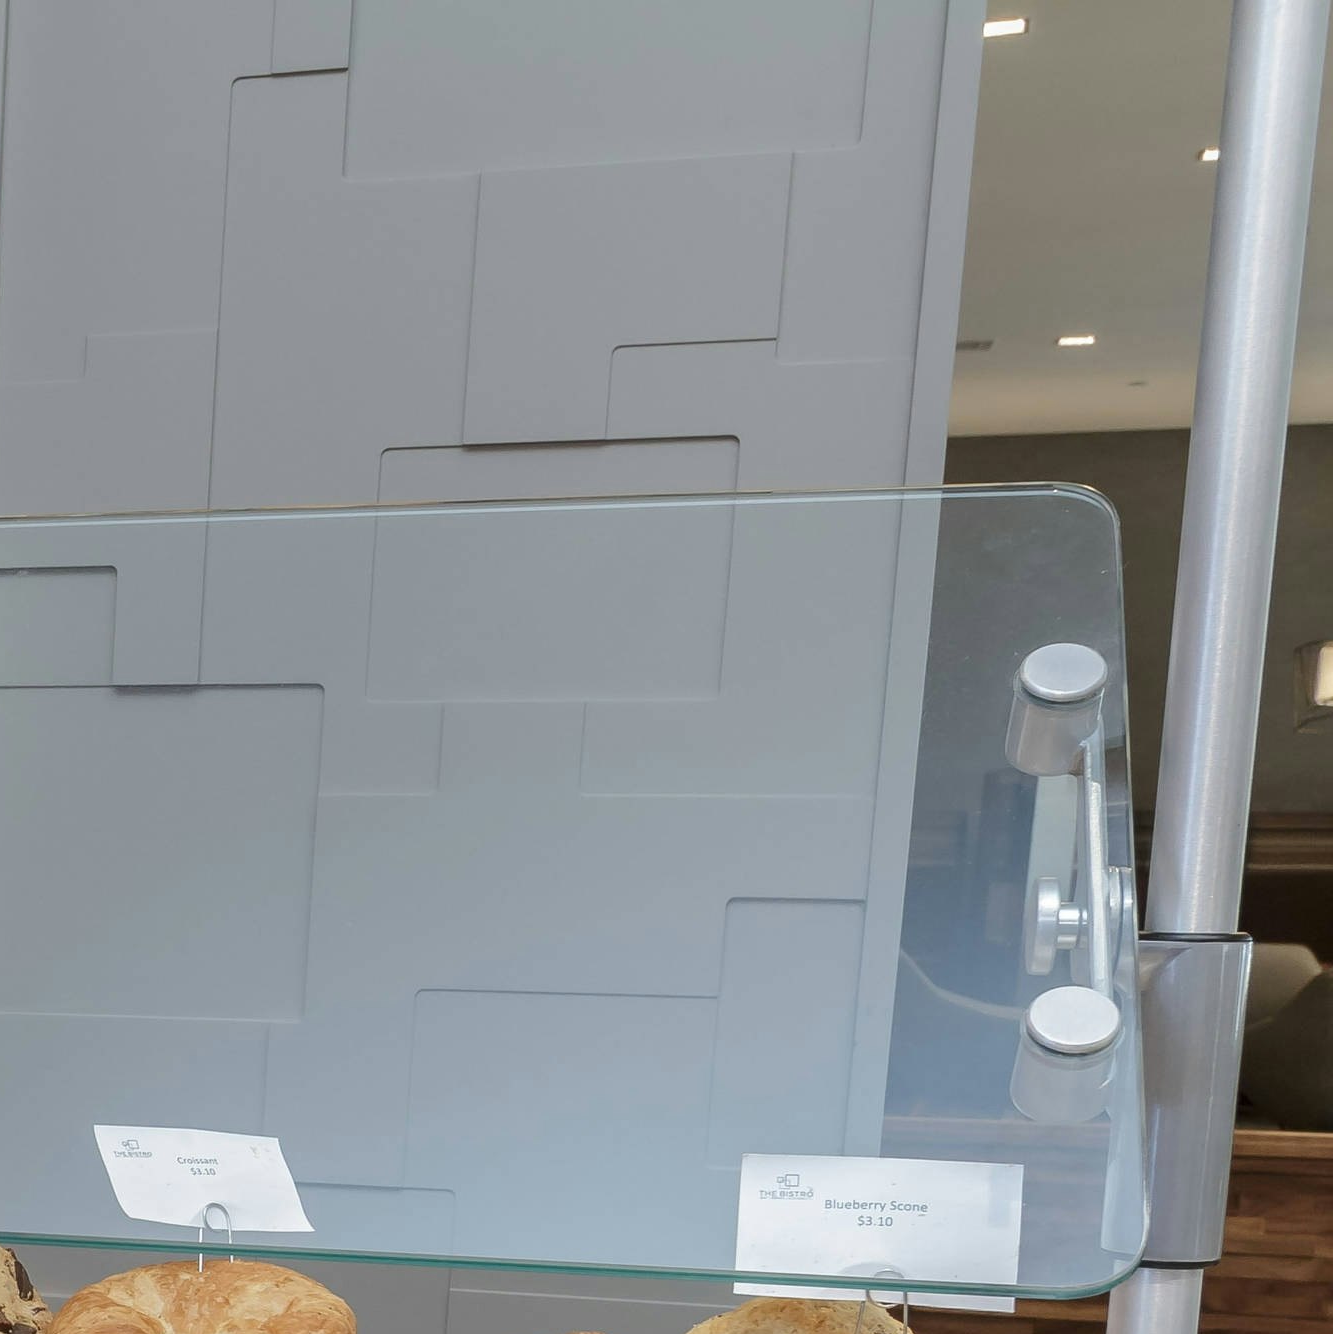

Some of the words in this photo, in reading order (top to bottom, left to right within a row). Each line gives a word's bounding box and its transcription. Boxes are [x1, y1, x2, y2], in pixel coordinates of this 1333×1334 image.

[176, 1156, 219, 1165] Croissant
[190, 1167, 216, 1176] $3.10
[759, 1189, 777, 1198] THE
[779, 1189, 814, 1198] BISTRO
[824, 1199, 886, 1213] Blueberry
[889, 1200, 928, 1213] Scone
[857, 1215, 894, 1228] $3.10
